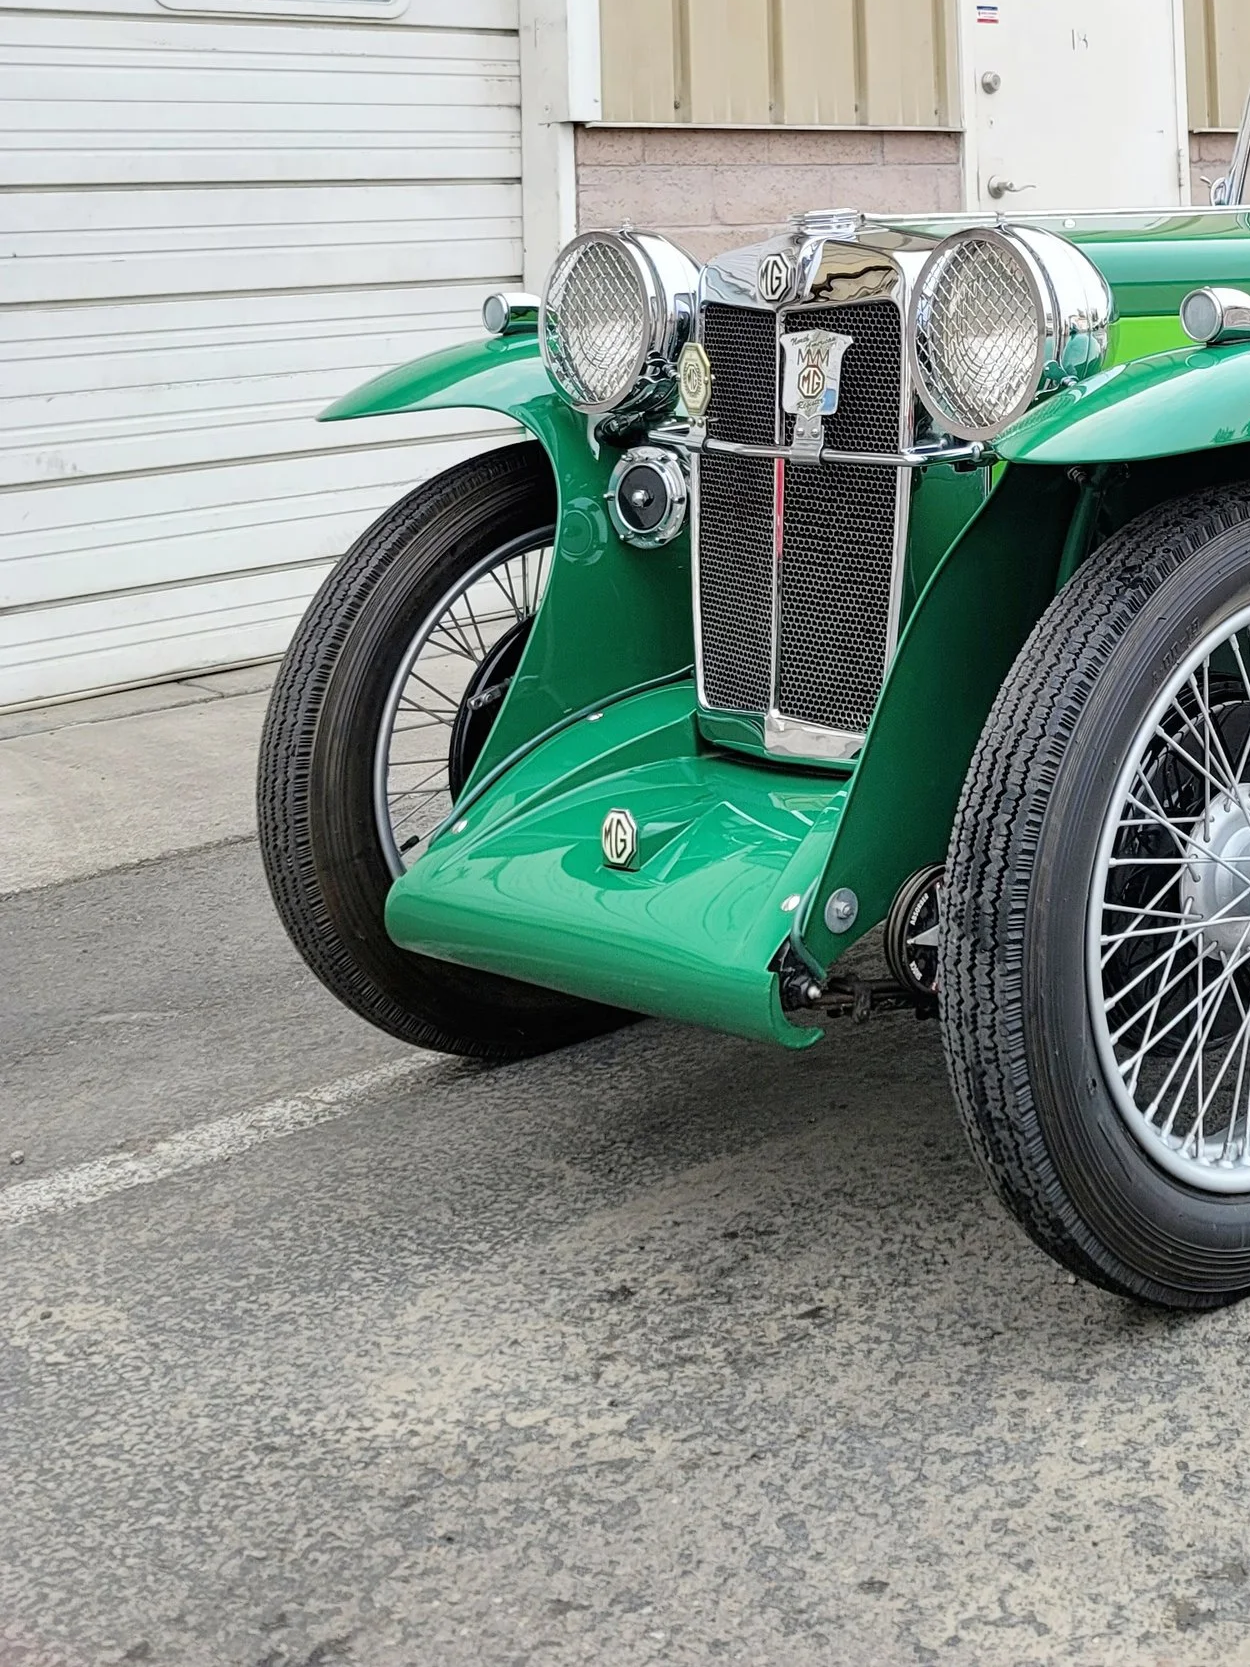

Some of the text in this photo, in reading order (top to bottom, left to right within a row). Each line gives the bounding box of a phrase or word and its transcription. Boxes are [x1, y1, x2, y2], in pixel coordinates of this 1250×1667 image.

[760, 258, 783, 297] MG
[801, 368, 822, 395] MG
[604, 817, 627, 860] MG
[909, 892, 929, 926] ABSORBER
